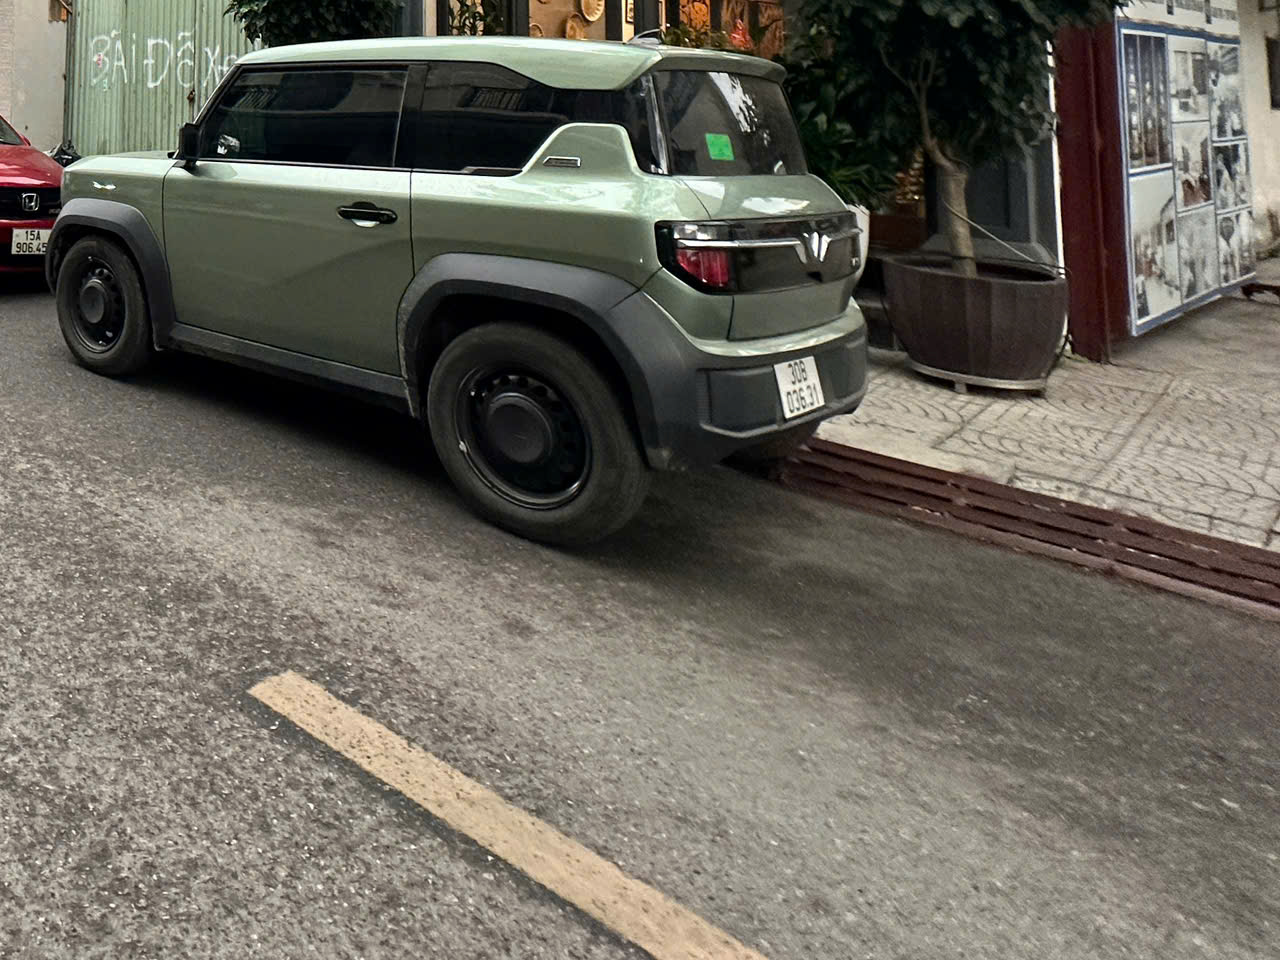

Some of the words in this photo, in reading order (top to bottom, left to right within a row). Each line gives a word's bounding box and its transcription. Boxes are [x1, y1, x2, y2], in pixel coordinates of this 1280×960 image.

[24, 230, 41, 241] 15A
[15, 242, 48, 253] 906.45
[787, 359, 808, 385] 30B
[786, 383, 820, 413] 036.31
